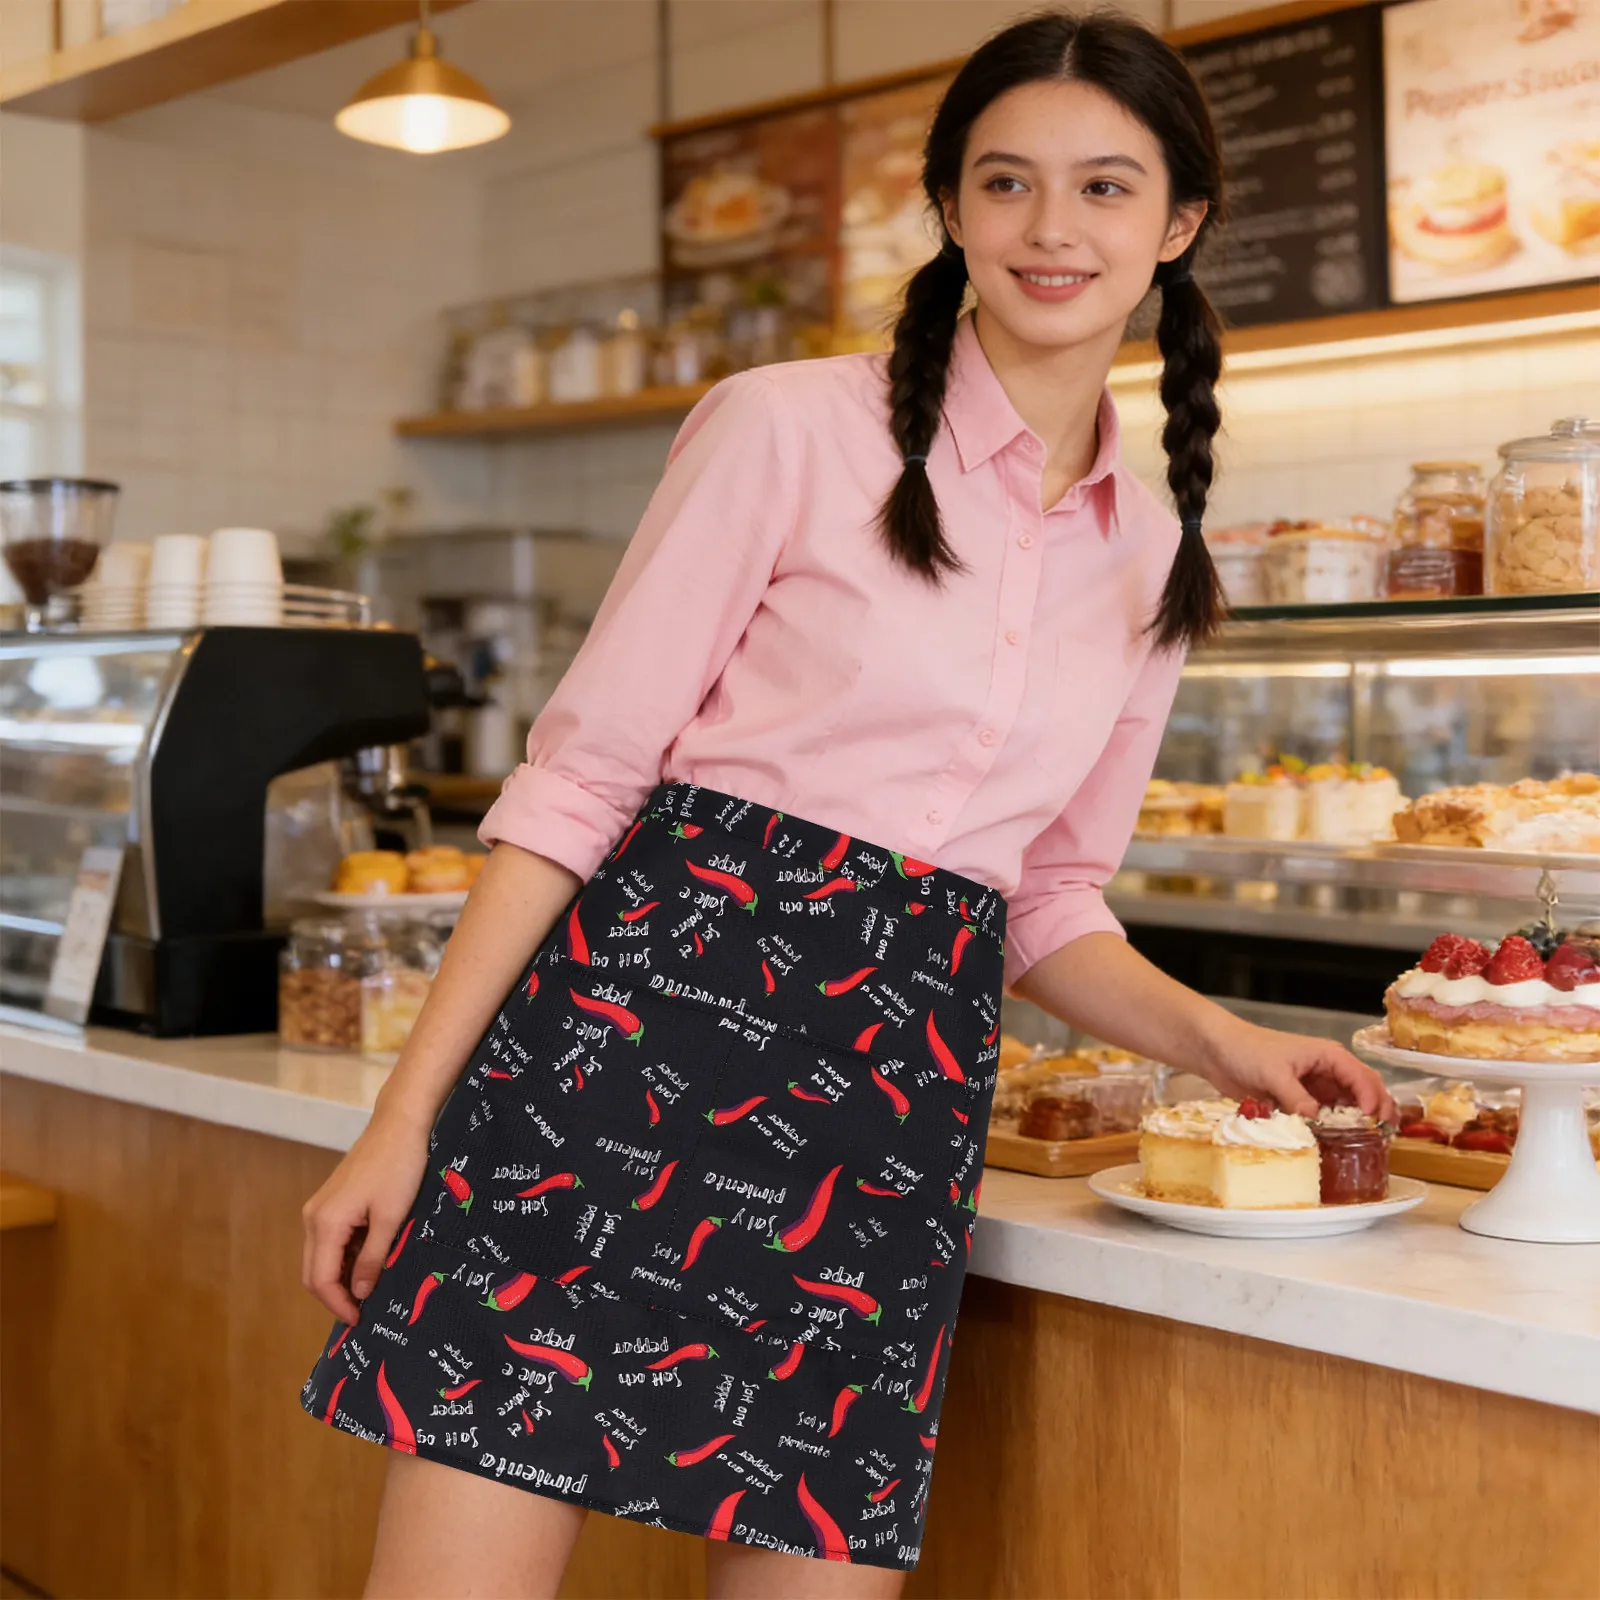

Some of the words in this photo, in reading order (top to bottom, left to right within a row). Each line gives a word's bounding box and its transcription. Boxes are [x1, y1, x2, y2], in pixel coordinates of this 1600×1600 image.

[708, 854, 746, 876] pepe
[679, 886, 690, 898] e
[607, 922, 649, 938] peper
[591, 951, 609, 967] og
[592, 983, 633, 1007] pepe
[563, 1016, 573, 1029] e
[622, 1160, 633, 1171] y
[703, 1172, 787, 1204] pimienta
[731, 1208, 746, 1225] y
[747, 1215, 779, 1240] Sal
[452, 1263, 466, 1281] y
[820, 1266, 864, 1288] pepe
[706, 1292, 718, 1304] e
[790, 1302, 803, 1314] e
[808, 1306, 848, 1329] Sale
[530, 1328, 576, 1351] pepe
[502, 1363, 513, 1376] e
[518, 1368, 558, 1393] Sale
[872, 1373, 884, 1391] y
[429, 1400, 473, 1416] peper
[417, 1429, 436, 1445] og
[445, 1427, 479, 1448] Salt
[477, 1453, 588, 1496] pimienta
[734, 1451, 783, 1484] pepper
